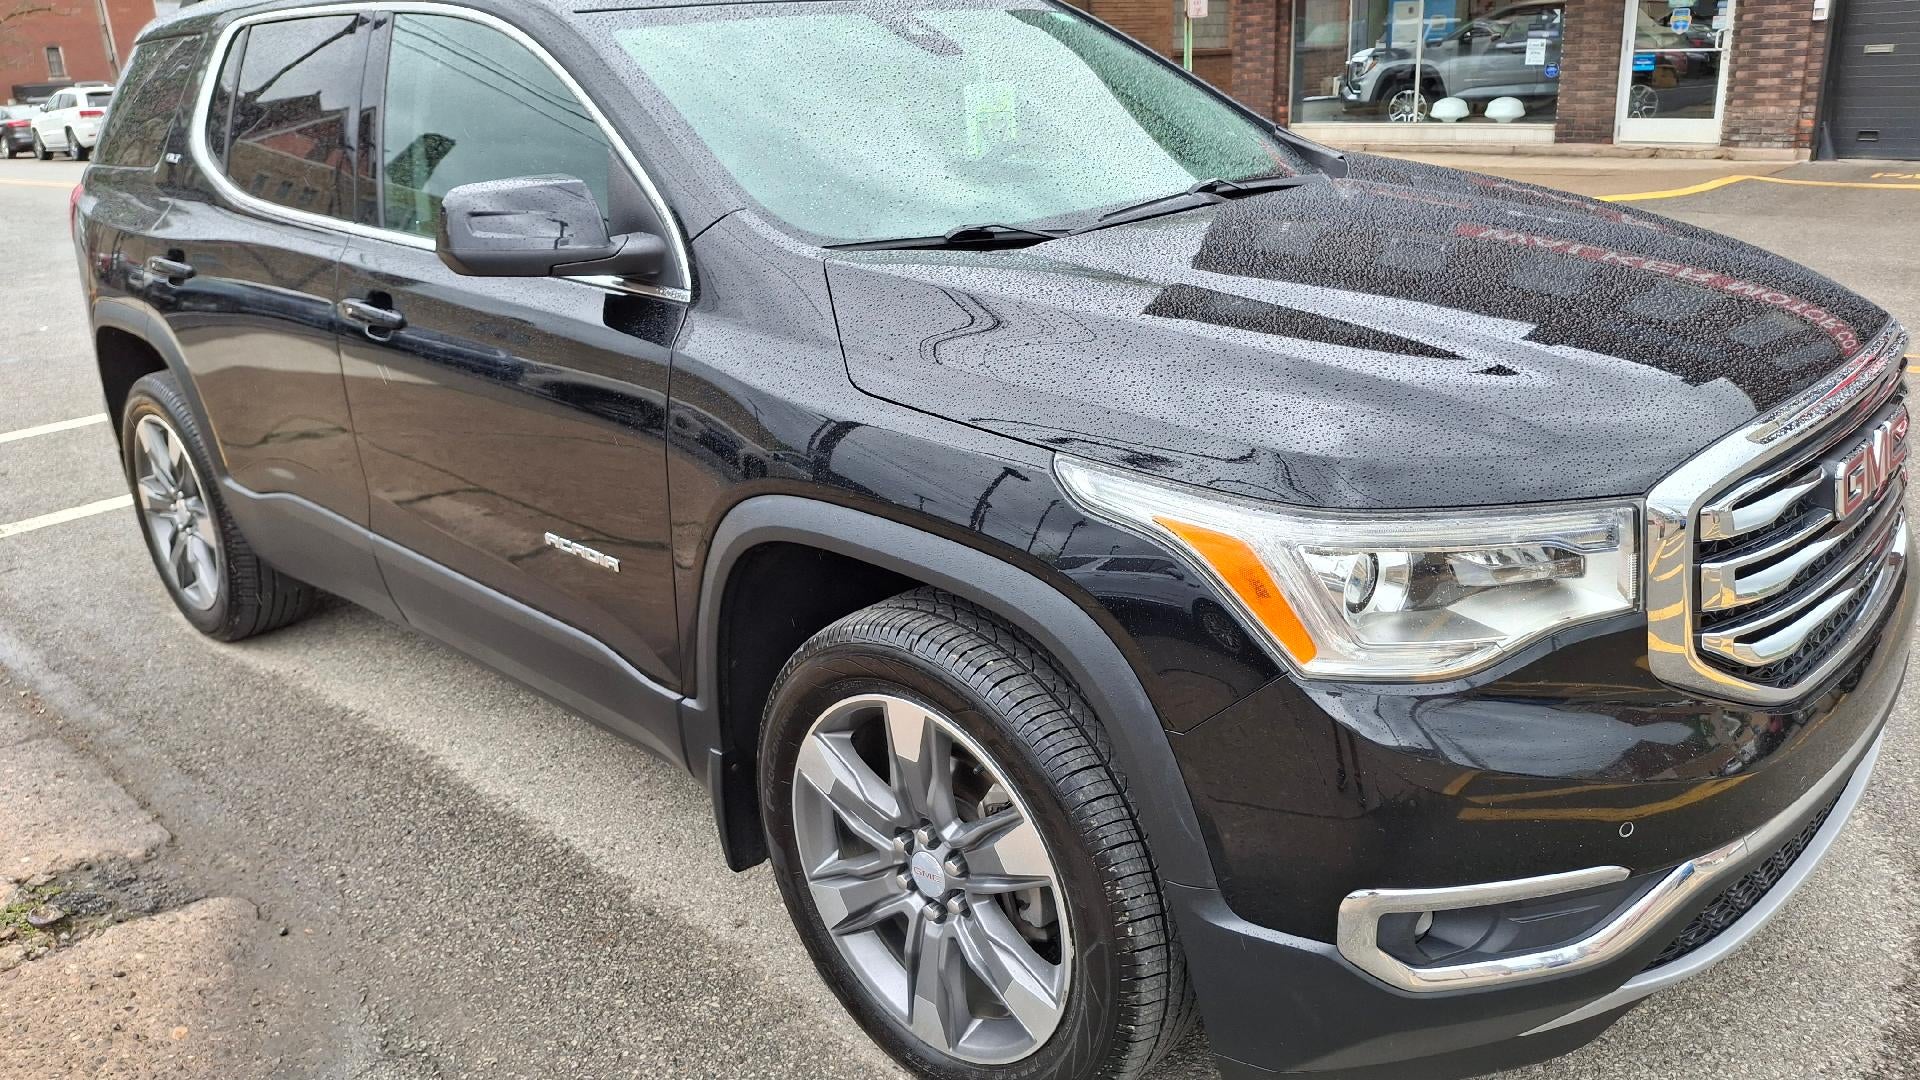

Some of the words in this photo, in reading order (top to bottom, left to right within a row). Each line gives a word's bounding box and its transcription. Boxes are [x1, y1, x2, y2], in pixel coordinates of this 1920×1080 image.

[1835, 404, 1909, 518] GMC
[544, 531, 621, 573] ACADIA
[913, 866, 943, 884] GMC
